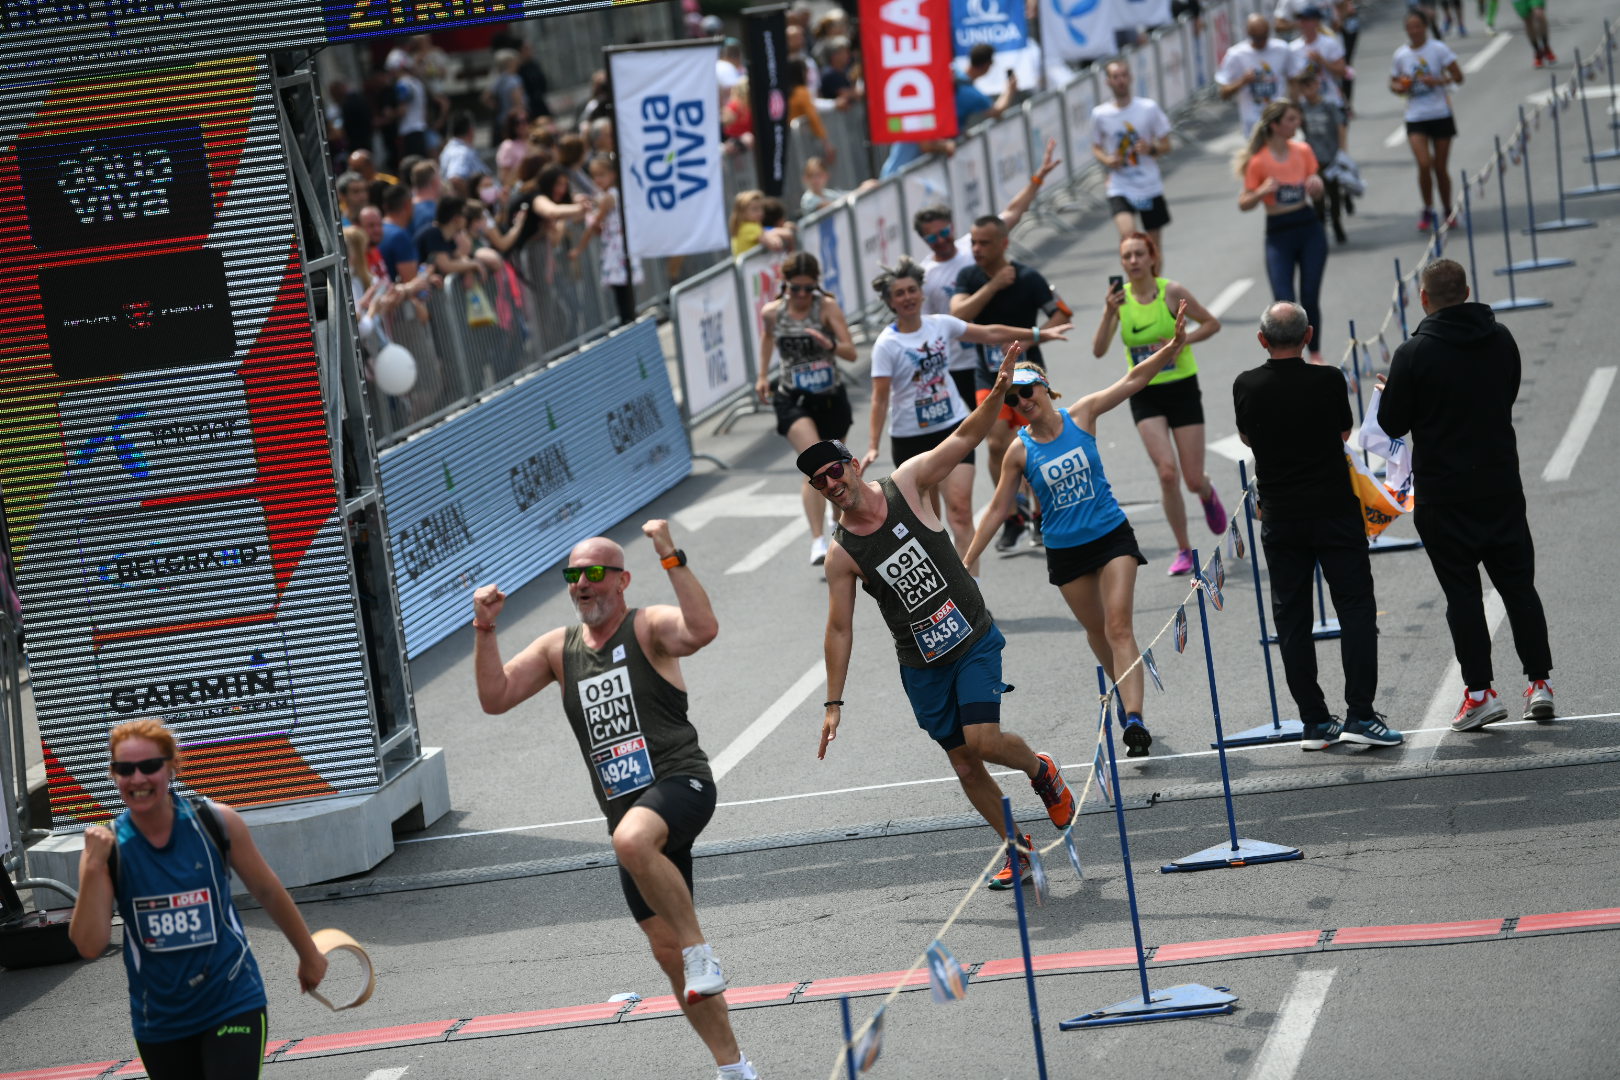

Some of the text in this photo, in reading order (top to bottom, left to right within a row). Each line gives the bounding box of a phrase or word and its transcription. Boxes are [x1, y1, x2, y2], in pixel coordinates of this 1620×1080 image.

[879, 0, 936, 133] iDEA
[641, 94, 676, 211] aqua
[1047, 453, 1084, 481] 091
[1054, 470, 1088, 494] RUN
[1057, 484, 1088, 505] CrW
[886, 545, 922, 579] 091
[896, 561, 932, 593] RUN
[905, 575, 939, 606] CrW
[935, 604, 952, 621] iDEA
[921, 616, 960, 649] 5436
[110, 670, 277, 713] GARMIN
[585, 674, 625, 703] 091
[588, 697, 630, 725] RUN
[592, 714, 632, 741] CrW
[616, 740, 641, 756] iDEA
[600, 756, 641, 785] 4924
[147, 908, 202, 937] 5883
